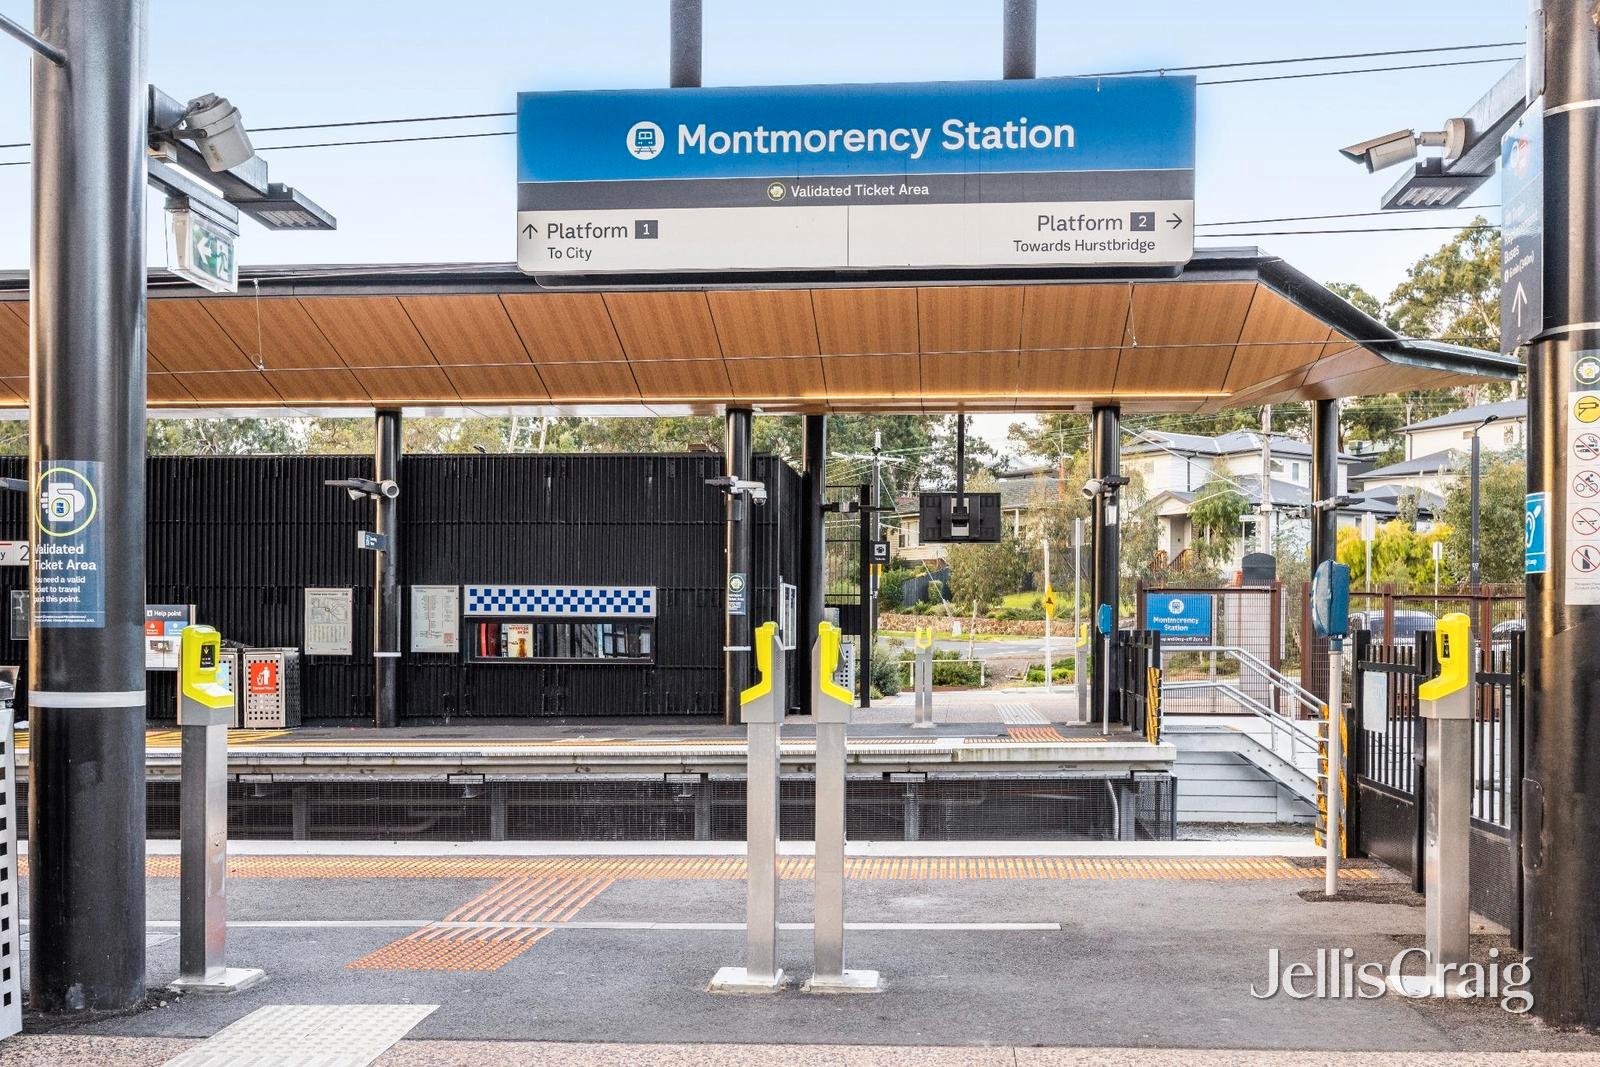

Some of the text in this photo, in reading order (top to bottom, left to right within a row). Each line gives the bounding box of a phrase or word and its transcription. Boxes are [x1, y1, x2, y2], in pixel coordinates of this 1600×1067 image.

[678, 117, 1075, 159] Montmorency Station
[790, 183, 929, 198] Validated Ticket Area
[547, 222, 650, 239] Platform 1
[1037, 214, 1147, 232] Platform 2
[547, 246, 592, 261] To City
[1013, 238, 1156, 254] Towards Hurstbridge
[20, 545, 30, 561] 2
[34, 544, 84, 555] Validated
[34, 559, 97, 570] Ticket Area
[67, 575, 86, 584] valid
[50, 585, 58, 593] to
[45, 595, 58, 603] this
[59, 595, 81, 605] point.
[153, 610, 182, 619] Help point
